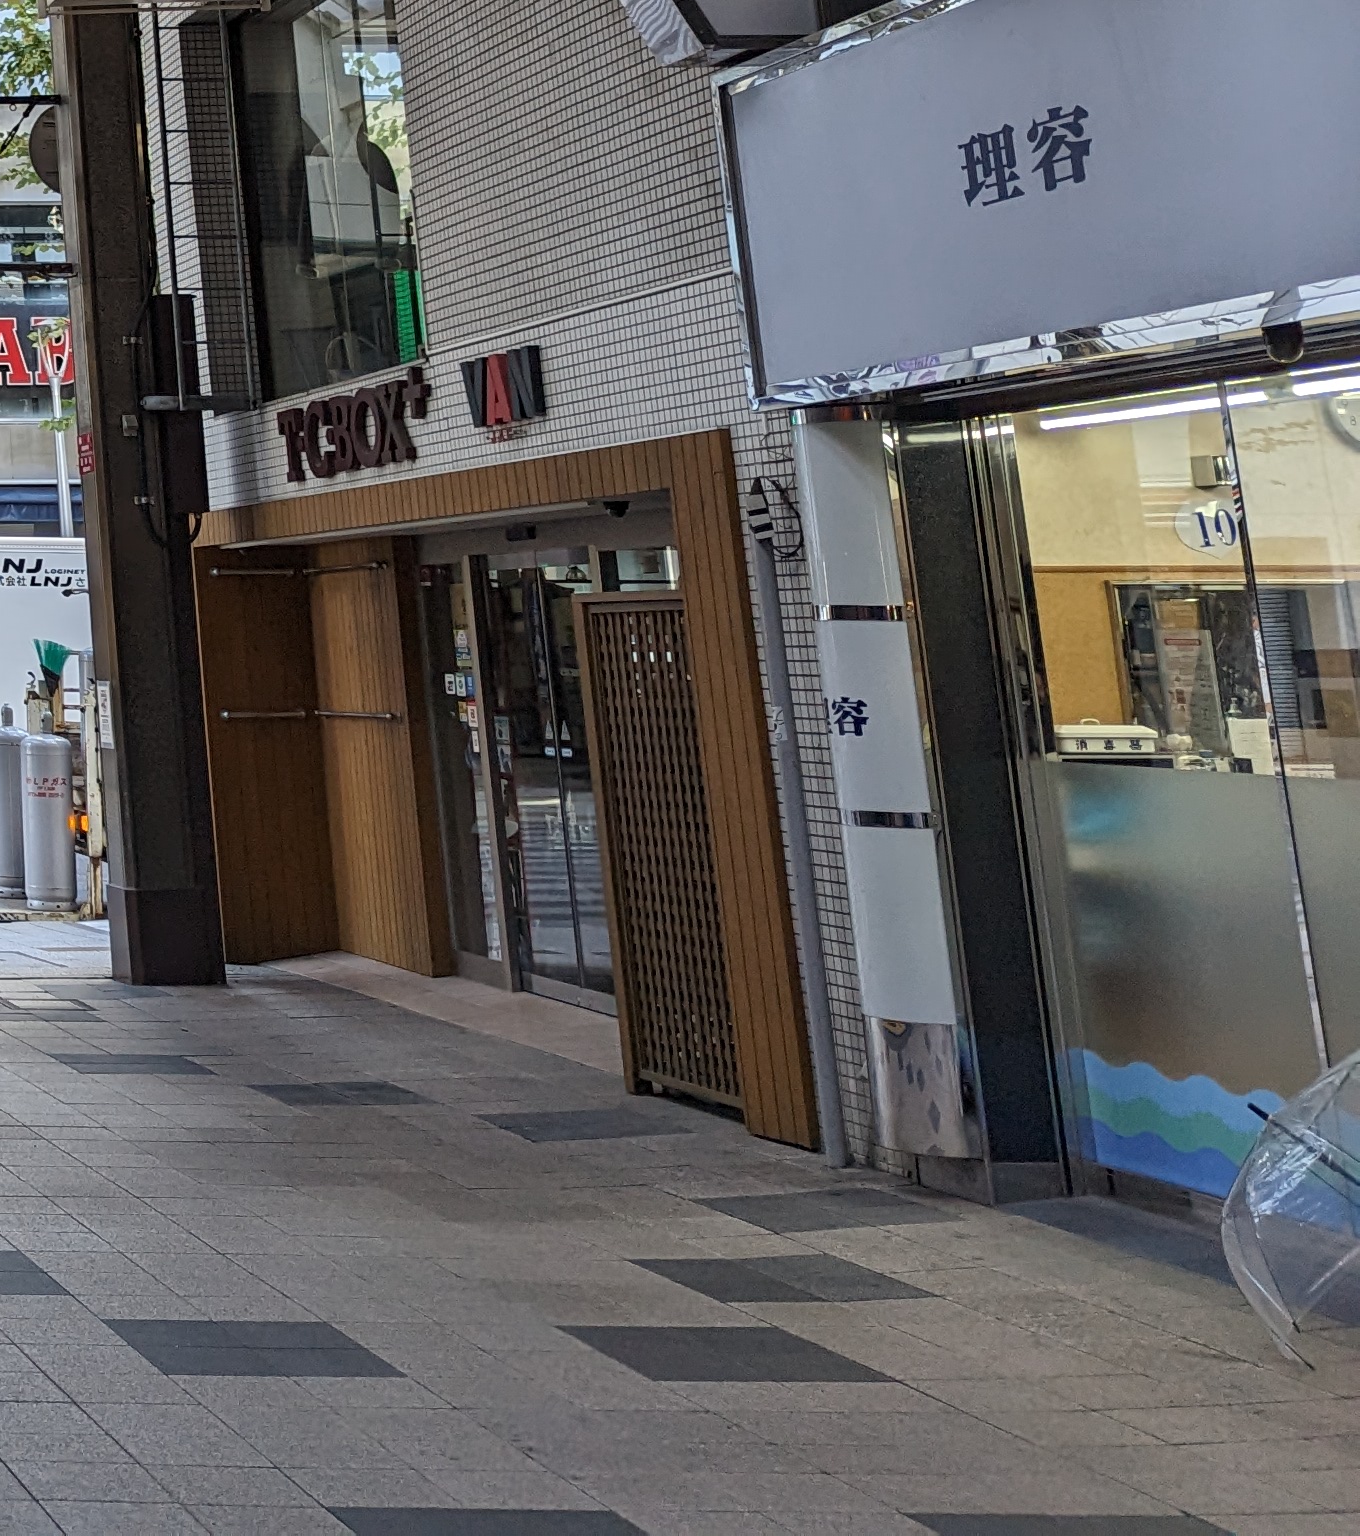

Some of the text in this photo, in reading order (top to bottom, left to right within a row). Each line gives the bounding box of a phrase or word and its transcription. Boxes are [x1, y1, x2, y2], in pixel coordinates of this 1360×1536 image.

[957, 103, 1093, 208] 理容
[1191, 508, 1237, 548] 10
[824, 696, 870, 737] 容
